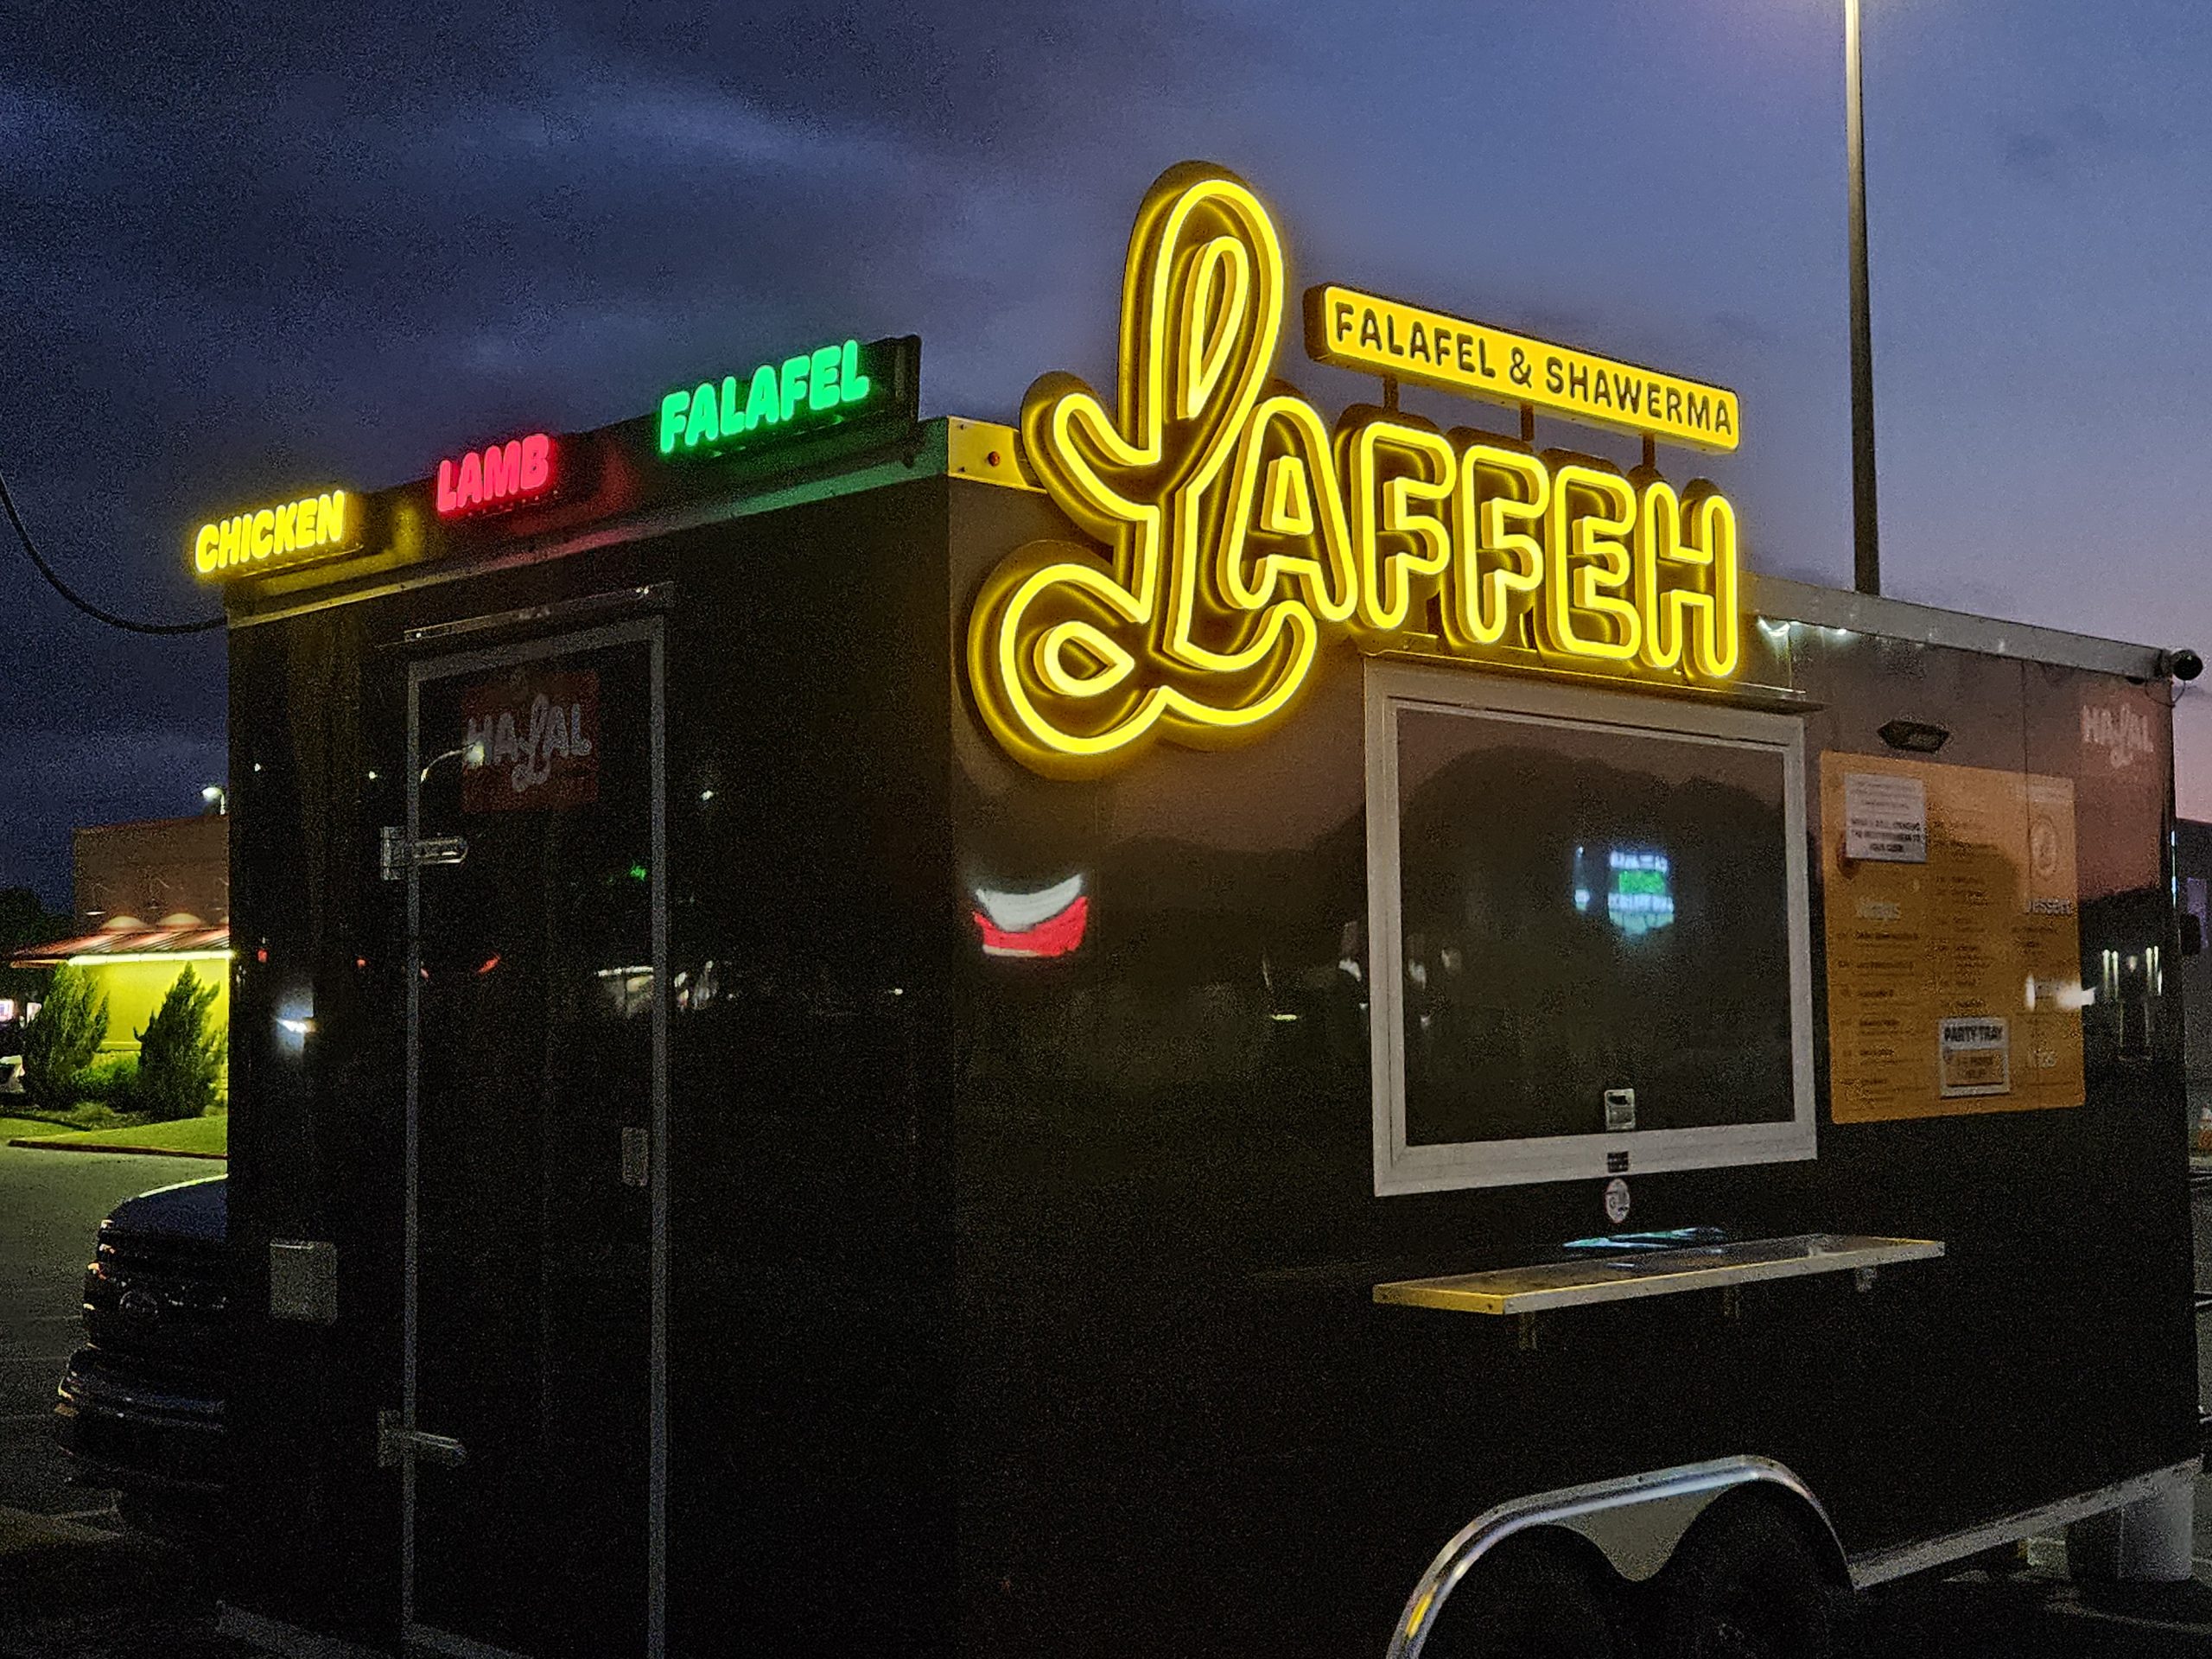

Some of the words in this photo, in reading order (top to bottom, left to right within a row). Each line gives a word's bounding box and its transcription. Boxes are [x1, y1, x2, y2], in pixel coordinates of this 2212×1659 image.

[660, 340, 869, 454] FALAFEL
[1333, 302, 1497, 381] FALAFEL
[1508, 347, 1534, 386] &
[1545, 359, 1733, 437] SHAWERMA
[435, 433, 556, 513] LAMB
[992, 173, 1738, 759] LAFFEH
[194, 489, 346, 574] CHICKEN
[464, 693, 594, 793] HALAL
